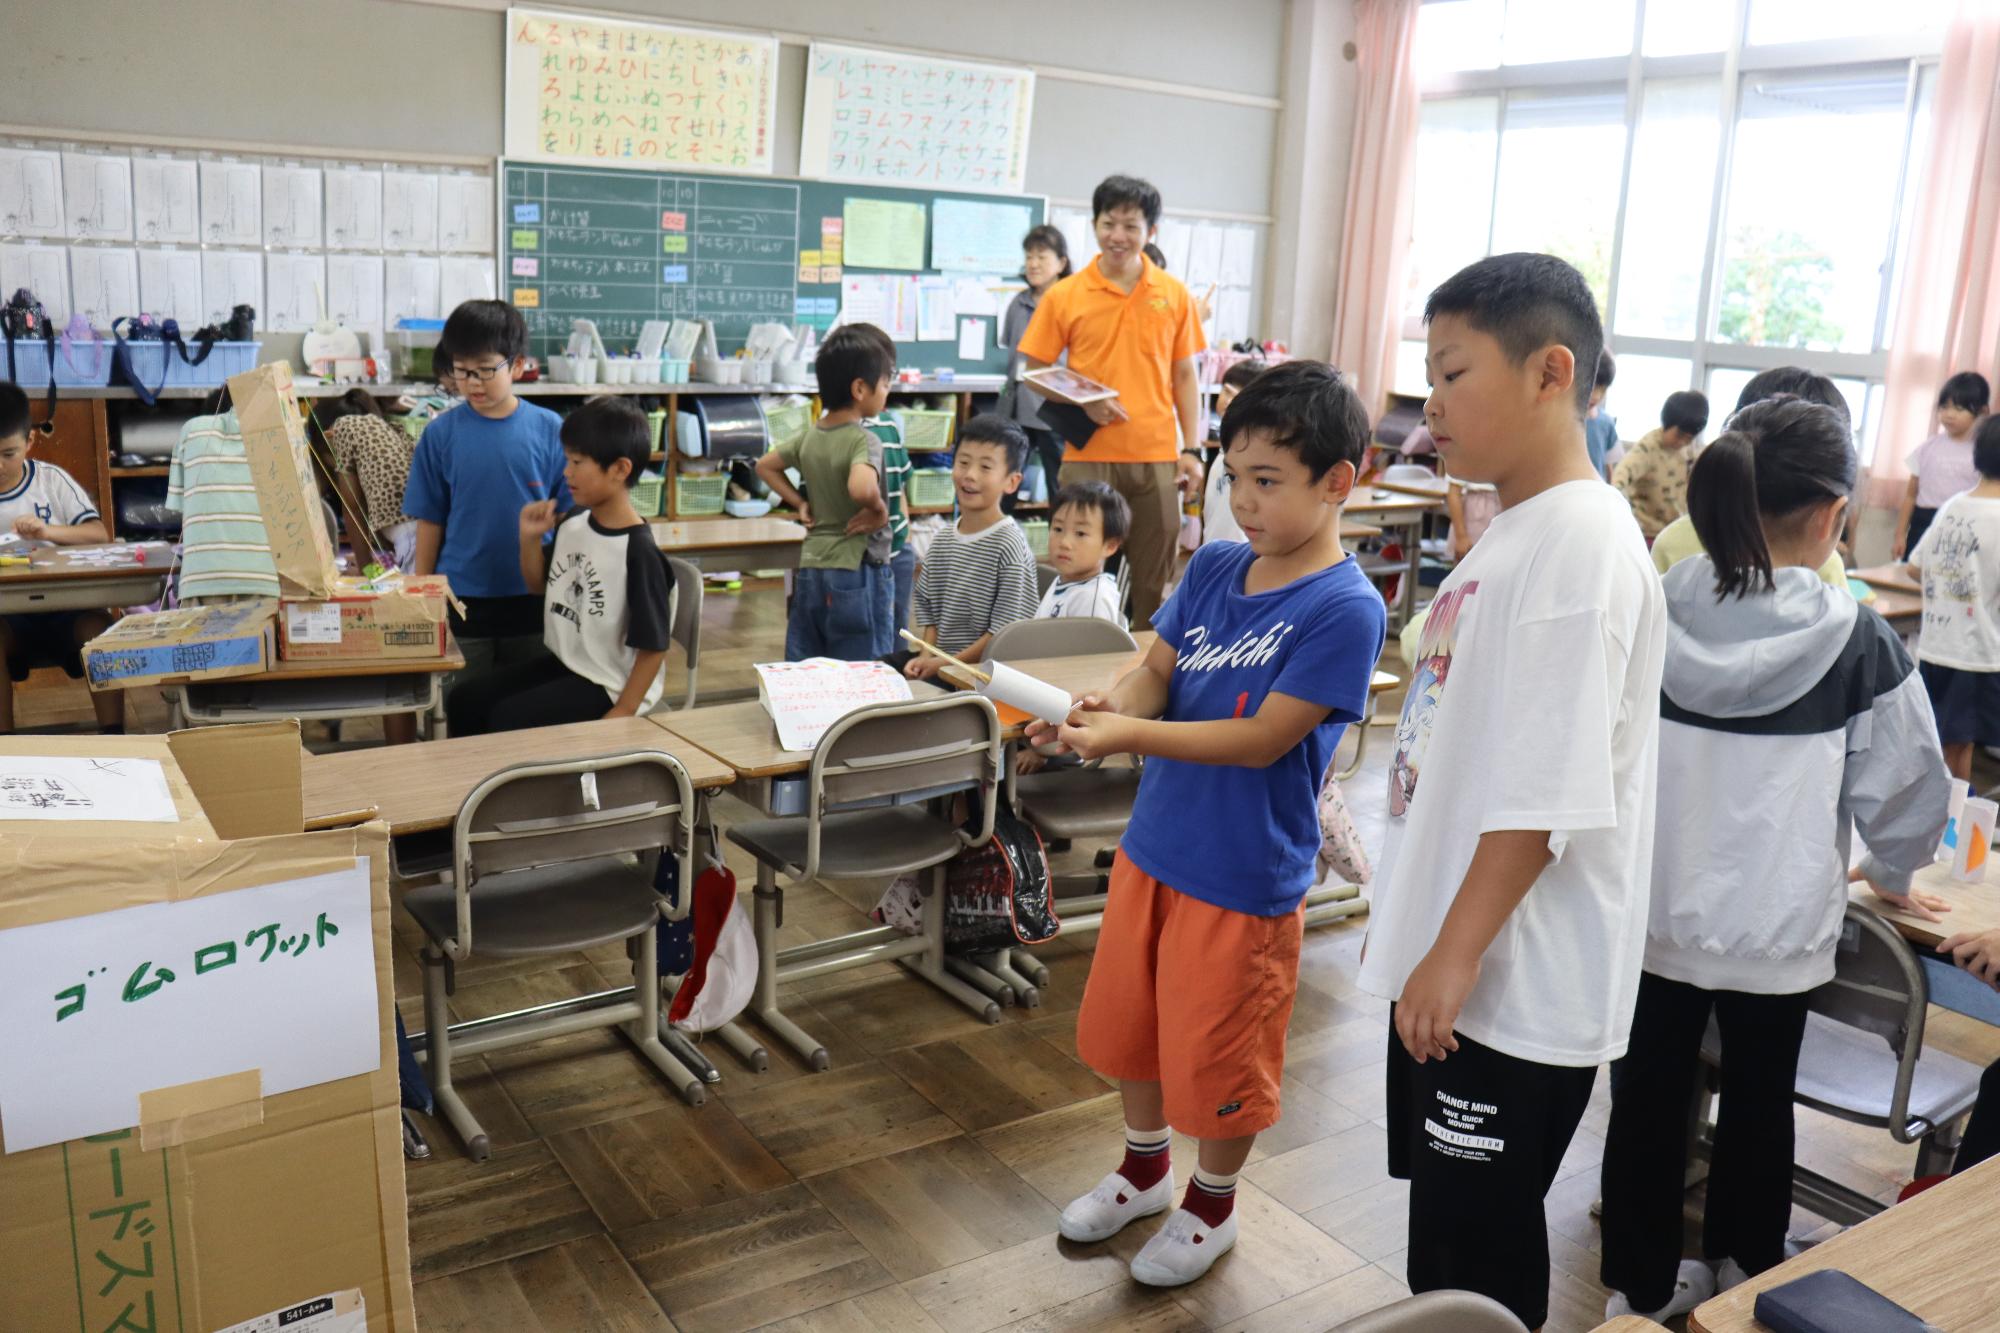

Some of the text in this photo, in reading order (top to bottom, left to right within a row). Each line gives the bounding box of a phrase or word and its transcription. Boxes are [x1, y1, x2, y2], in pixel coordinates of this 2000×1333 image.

[547, 561, 567, 587] ALL
[567, 552, 586, 570] TIME
[583, 561, 604, 617] CHAMPS
[54, 912, 339, 1023] ゴムロケット
[1436, 1090, 1498, 1115] CHANGE MIND
[1447, 1118, 1475, 1131] MOVING
[1462, 1114, 1484, 1124] QUICK
